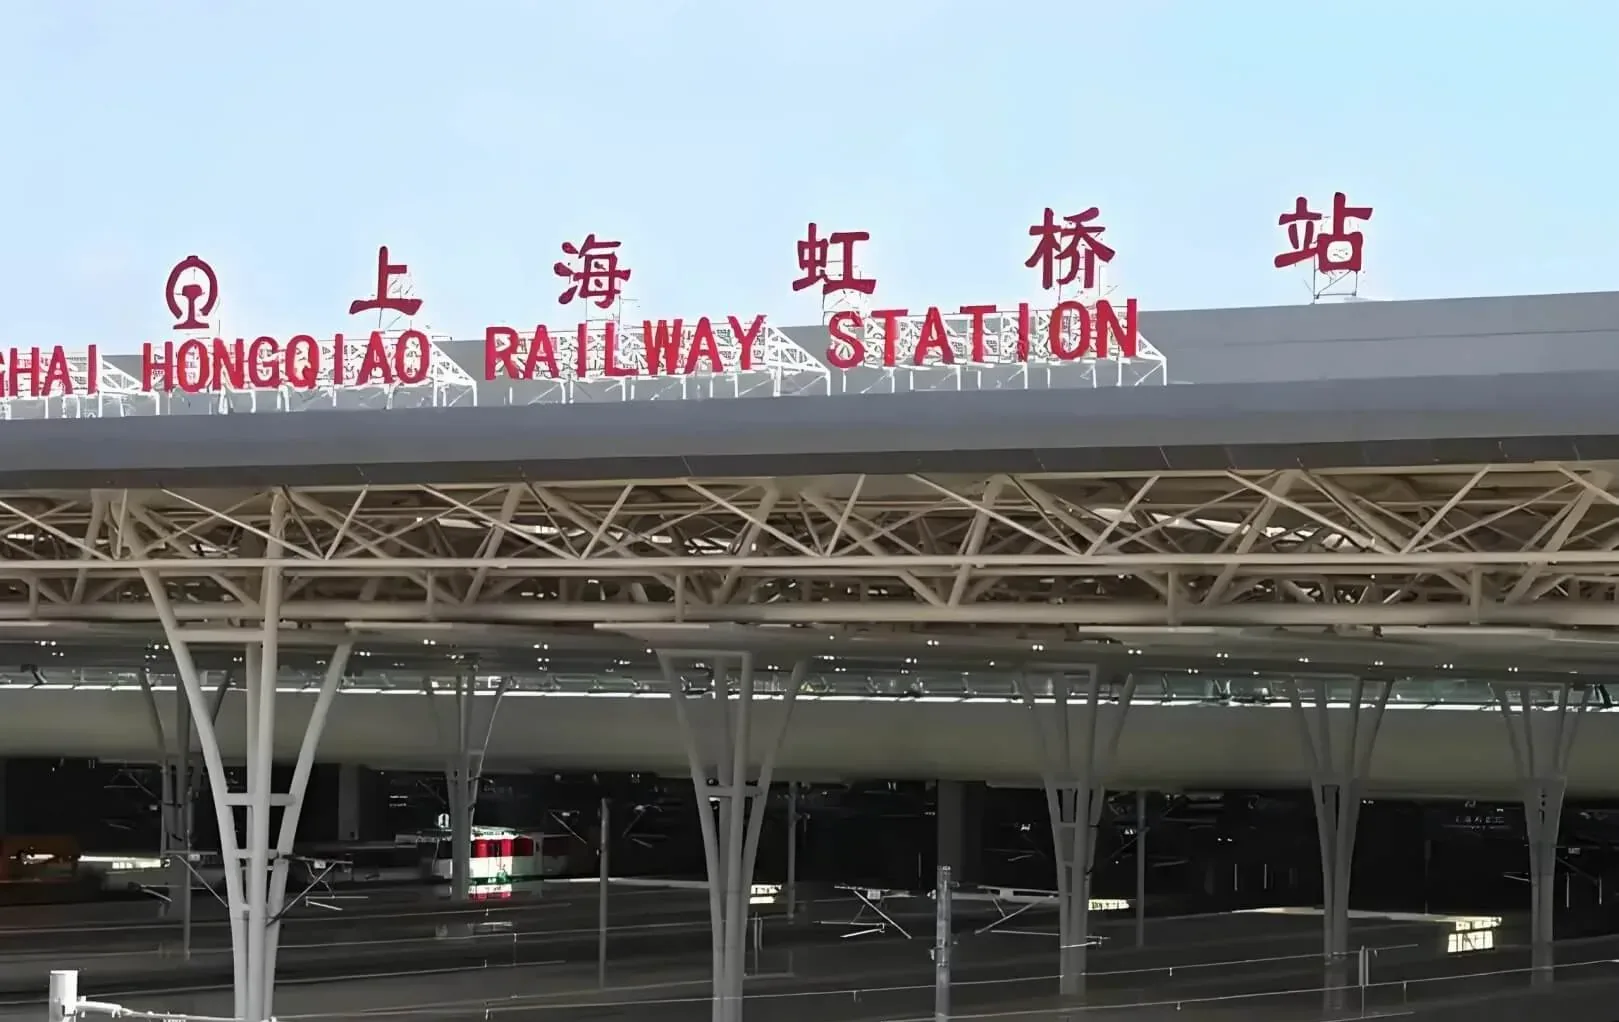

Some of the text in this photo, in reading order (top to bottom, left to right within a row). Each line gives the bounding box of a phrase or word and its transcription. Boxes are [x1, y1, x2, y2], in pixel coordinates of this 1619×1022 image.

[350, 192, 1372, 315] 上海虹桥站
[0, 298, 1138, 398] HAI HONGQIAO RAILWAY STATION
